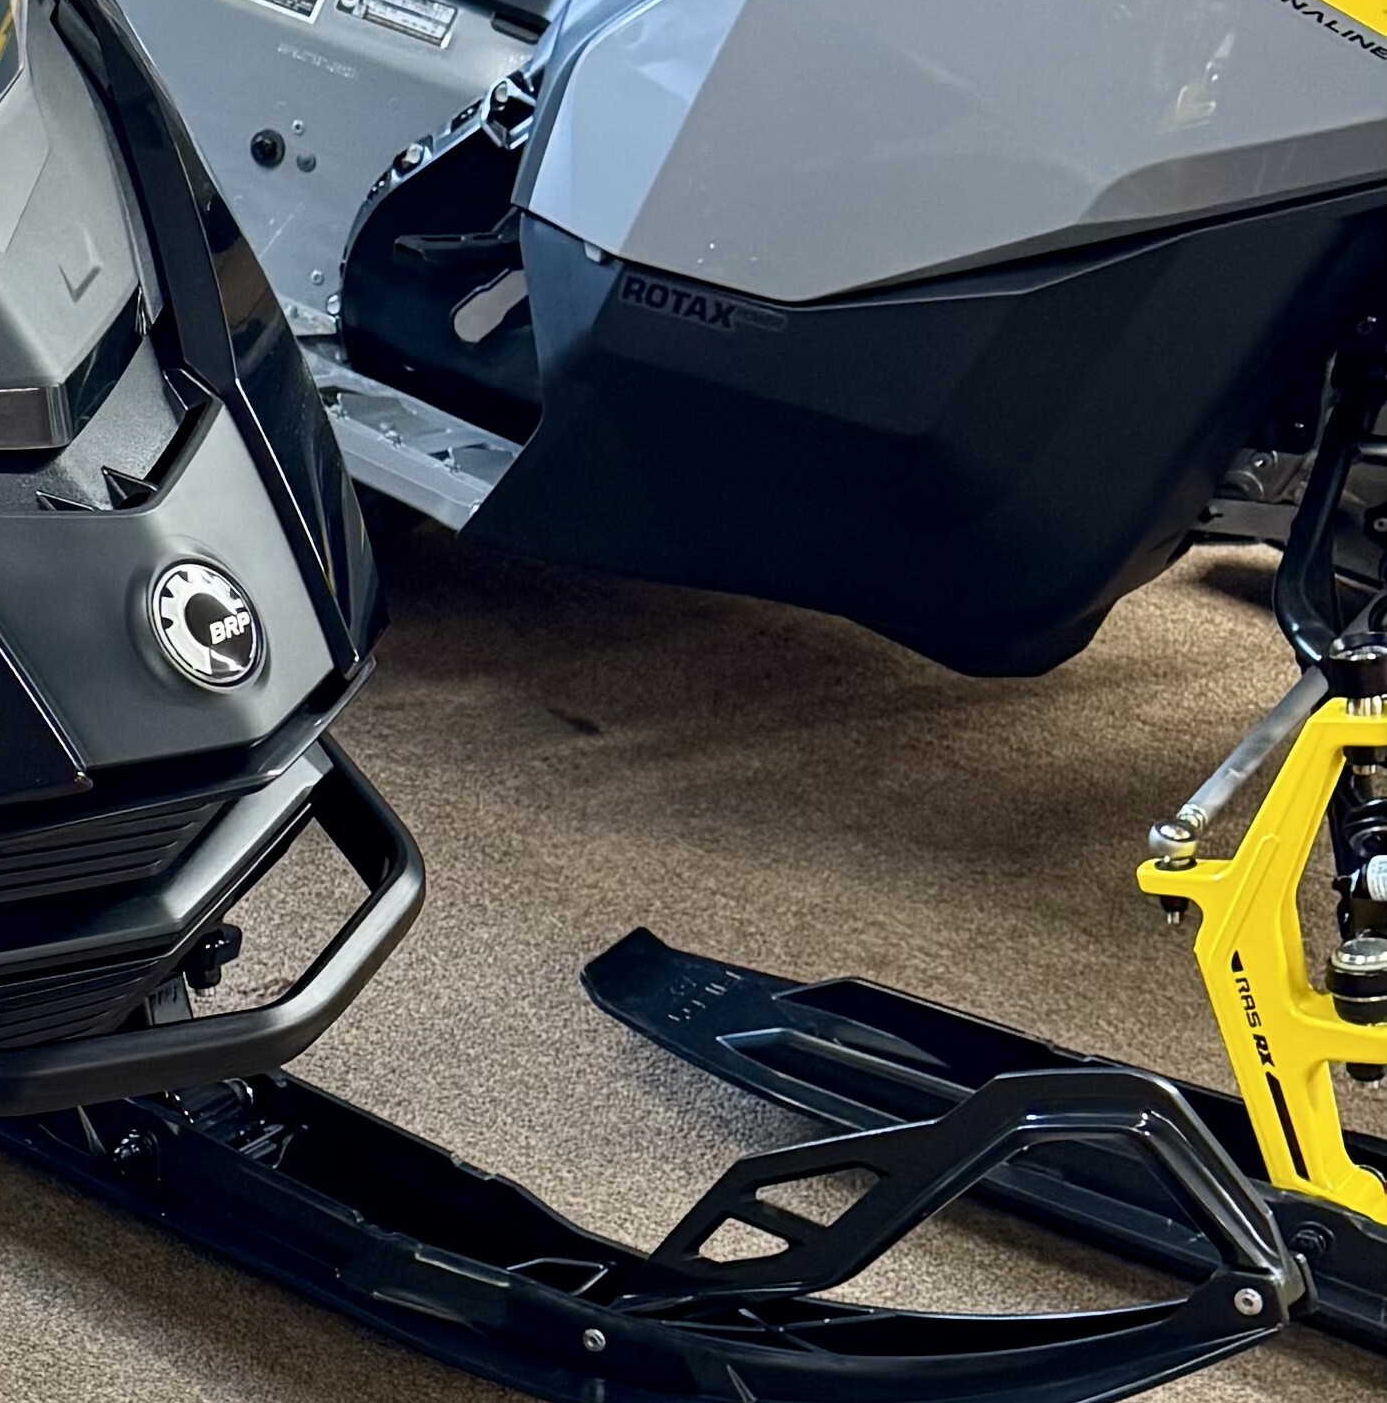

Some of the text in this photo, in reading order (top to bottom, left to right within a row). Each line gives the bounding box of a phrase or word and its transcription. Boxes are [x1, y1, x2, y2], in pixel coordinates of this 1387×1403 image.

[621, 275, 736, 329] ROTAX
[209, 610, 251, 646] BRP
[1235, 977, 1276, 1068] RAS RX
